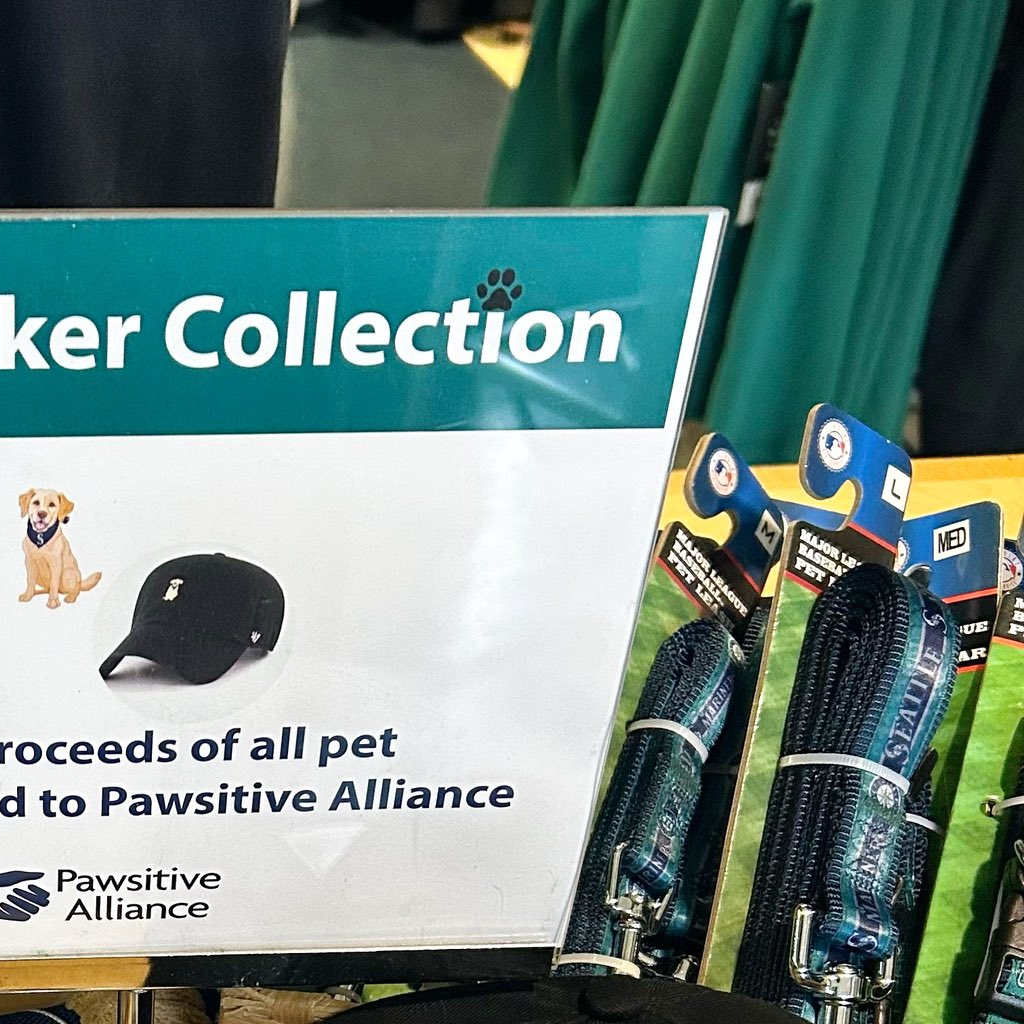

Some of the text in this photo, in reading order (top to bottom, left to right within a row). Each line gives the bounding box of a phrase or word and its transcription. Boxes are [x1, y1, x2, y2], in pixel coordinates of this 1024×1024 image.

[165, 290, 624, 371] Collection
[760, 520, 776, 544] M
[799, 528, 840, 560] MAJOR
[937, 526, 967, 554] MED
[666, 550, 696, 585] PET
[672, 540, 725, 608] BASEBALL
[675, 528, 749, 618] MAJOR LEAGUE
[794, 556, 826, 583] PET
[797, 542, 849, 577] BASEBA
[190, 727, 242, 763] of
[250, 726, 306, 762] all
[318, 726, 399, 768] pet
[39, 787, 86, 819] to
[100, 781, 317, 817] Pawsitive
[329, 778, 515, 812] Alliance
[56, 867, 222, 893] Pawsitive
[64, 897, 210, 922] Alliance
